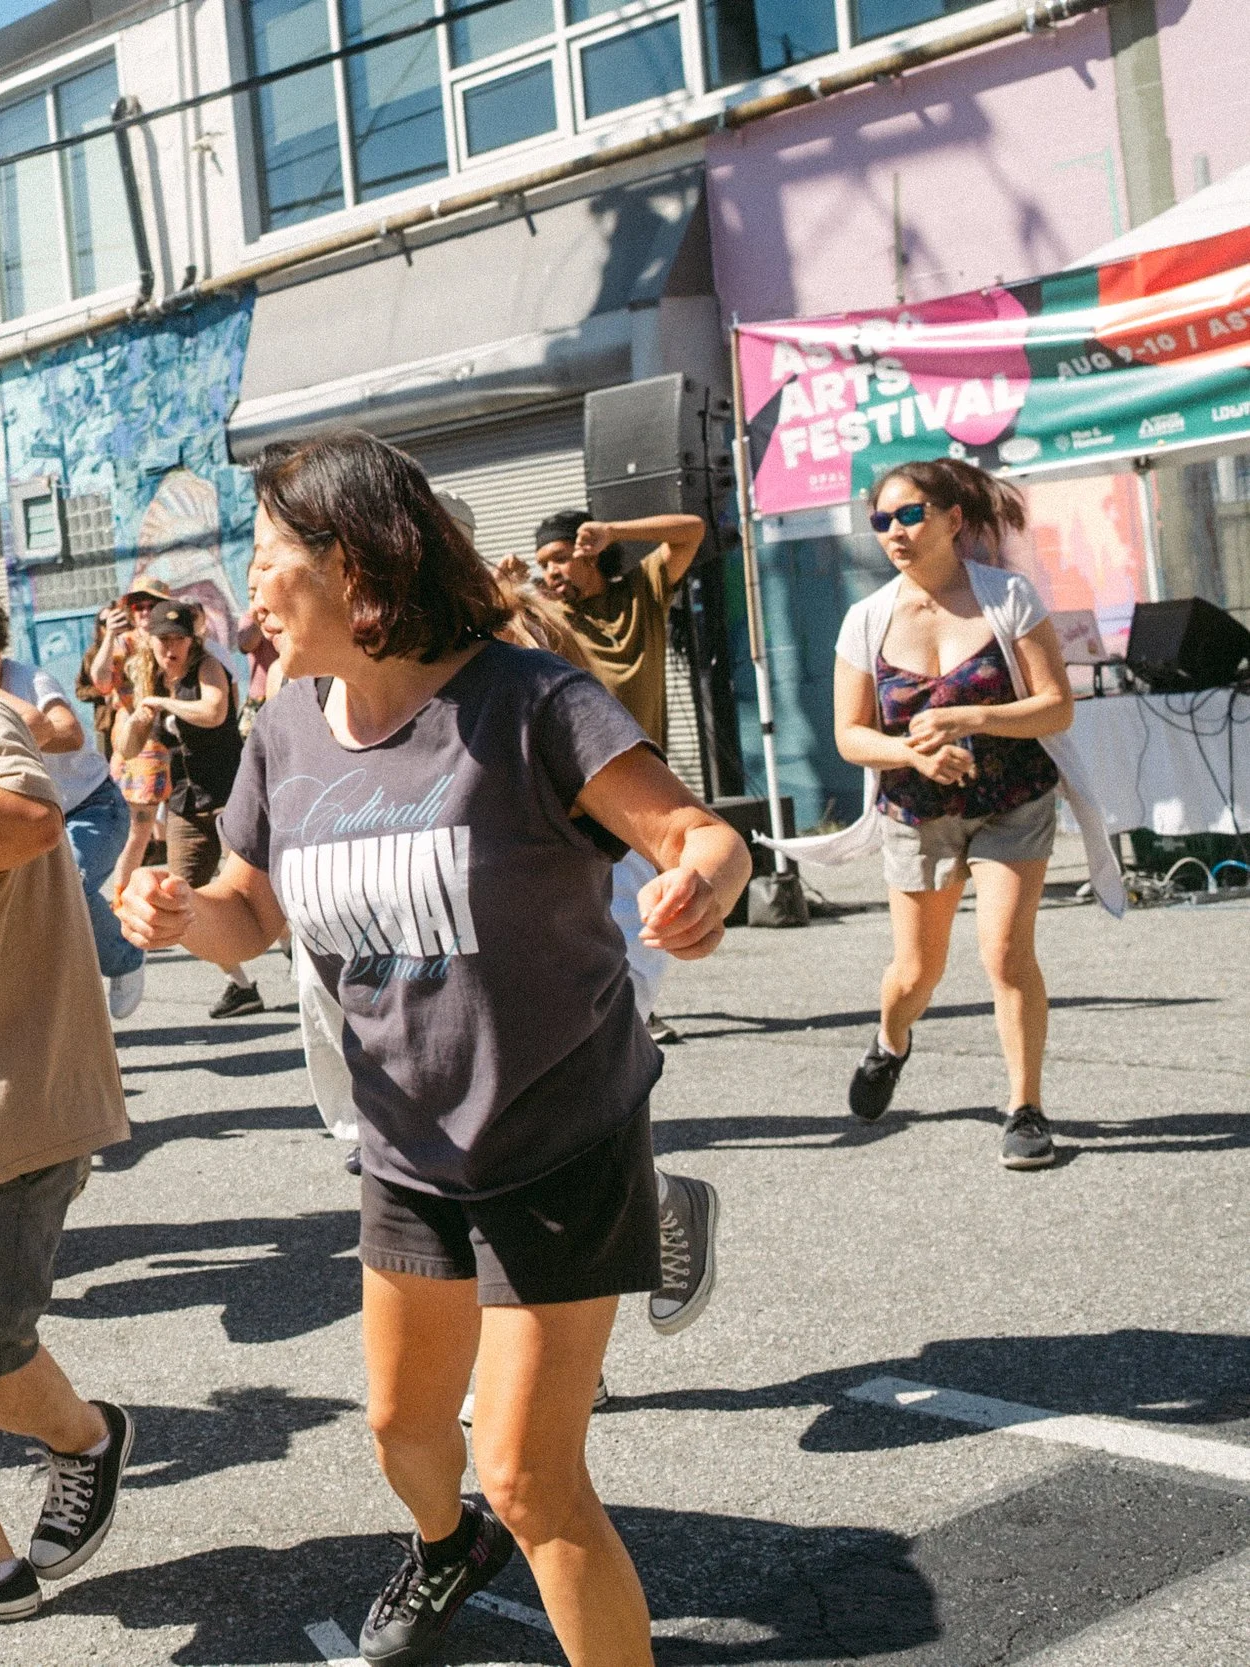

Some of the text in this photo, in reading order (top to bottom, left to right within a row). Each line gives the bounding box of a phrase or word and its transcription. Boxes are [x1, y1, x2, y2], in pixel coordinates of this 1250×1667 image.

[778, 357, 911, 425] ARTS
[1057, 351, 1112, 383] AUG
[1115, 333, 1177, 364] 9-10
[778, 373, 1025, 470] FESTIVAL
[270, 768, 456, 847] Culturally
[281, 825, 480, 961] RUNWAY
[340, 906, 462, 1005] Defined
